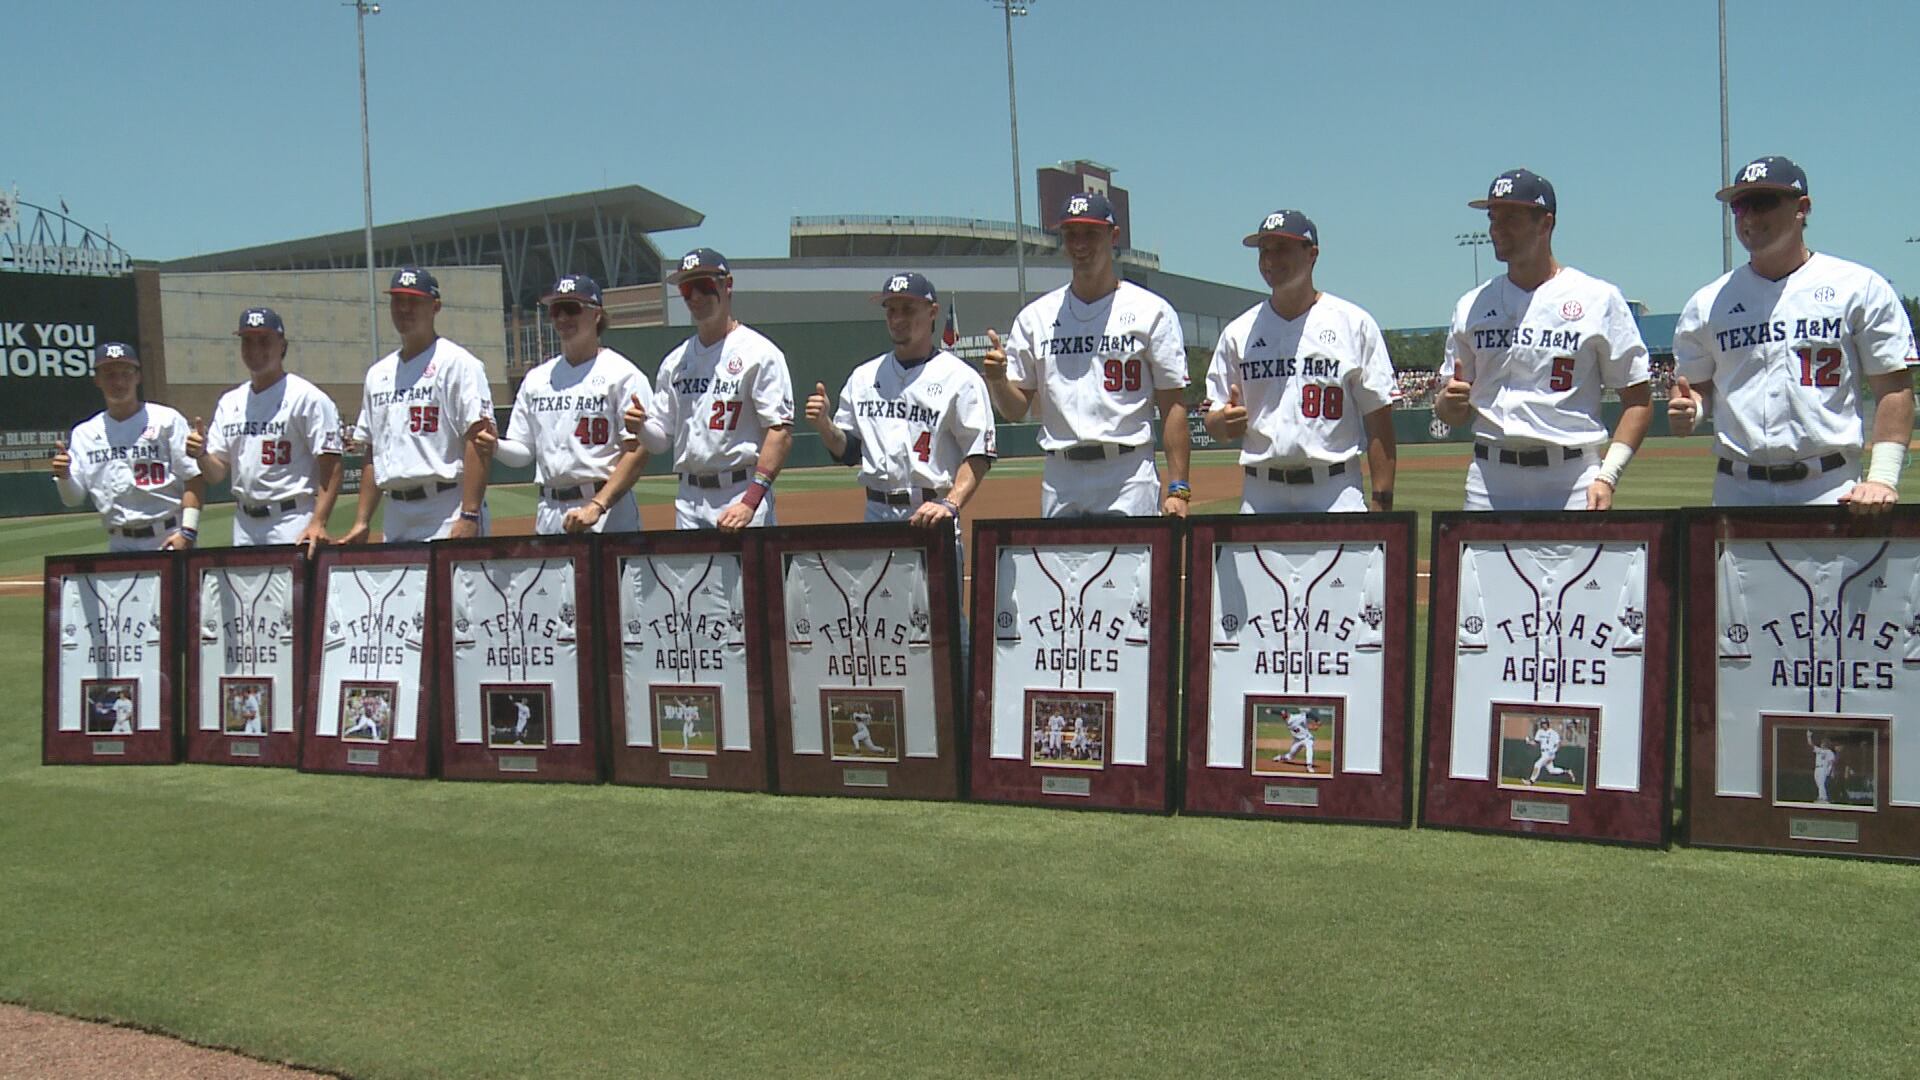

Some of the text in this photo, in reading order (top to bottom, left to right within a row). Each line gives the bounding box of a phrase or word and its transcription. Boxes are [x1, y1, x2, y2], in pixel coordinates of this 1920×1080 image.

[33, 322, 95, 348] YOU
[1041, 335, 1136, 356] TEXAS A&M
[1474, 327, 1581, 351] TEXAS A&M
[1716, 317, 1843, 352] TEXAS A&M
[1103, 359, 1141, 392] 99
[1239, 357, 1340, 380] TEXAS A&M
[1549, 356, 1576, 392] 5
[1797, 346, 1843, 388] 12
[372, 386, 433, 407] TEXAS A&M
[713, 378, 740, 395] A&M
[532, 396, 605, 412] TEXAS A&M
[857, 400, 940, 427] TEXAS A&M
[1301, 383, 1344, 420] 88
[409, 405, 439, 433] 55
[708, 401, 743, 431] 27
[223, 421, 285, 438] TEXAS A&M
[574, 417, 609, 445] 48
[86, 445, 159, 464] TEXAS A&M
[261, 440, 292, 465] 53
[913, 431, 932, 463] 4
[134, 462, 166, 487] 20
[84, 615, 146, 639] TEXAS
[223, 614, 279, 640] TEXAS
[348, 612, 408, 638] TEXAS
[480, 611, 557, 638] TEXAS
[649, 612, 725, 641] TEXAS
[819, 615, 907, 645] TEXAS
[1029, 606, 1124, 640] TEXAS
[1248, 607, 1355, 641] TEXAS
[1497, 611, 1612, 649] TEXAS
[1762, 610, 1899, 650] TEXAS
[88, 645, 142, 663] AGGIES
[227, 646, 277, 663] AGGIES
[349, 646, 403, 664] AGGIES
[487, 647, 554, 666] AGGIES
[656, 649, 723, 669] AGGIES
[829, 655, 907, 676] AGGIES
[1035, 648, 1118, 672] AGGIES
[1255, 650, 1349, 675] AGGIES
[1502, 656, 1606, 685] AGGIES
[1772, 660, 1893, 689] AGGIES
